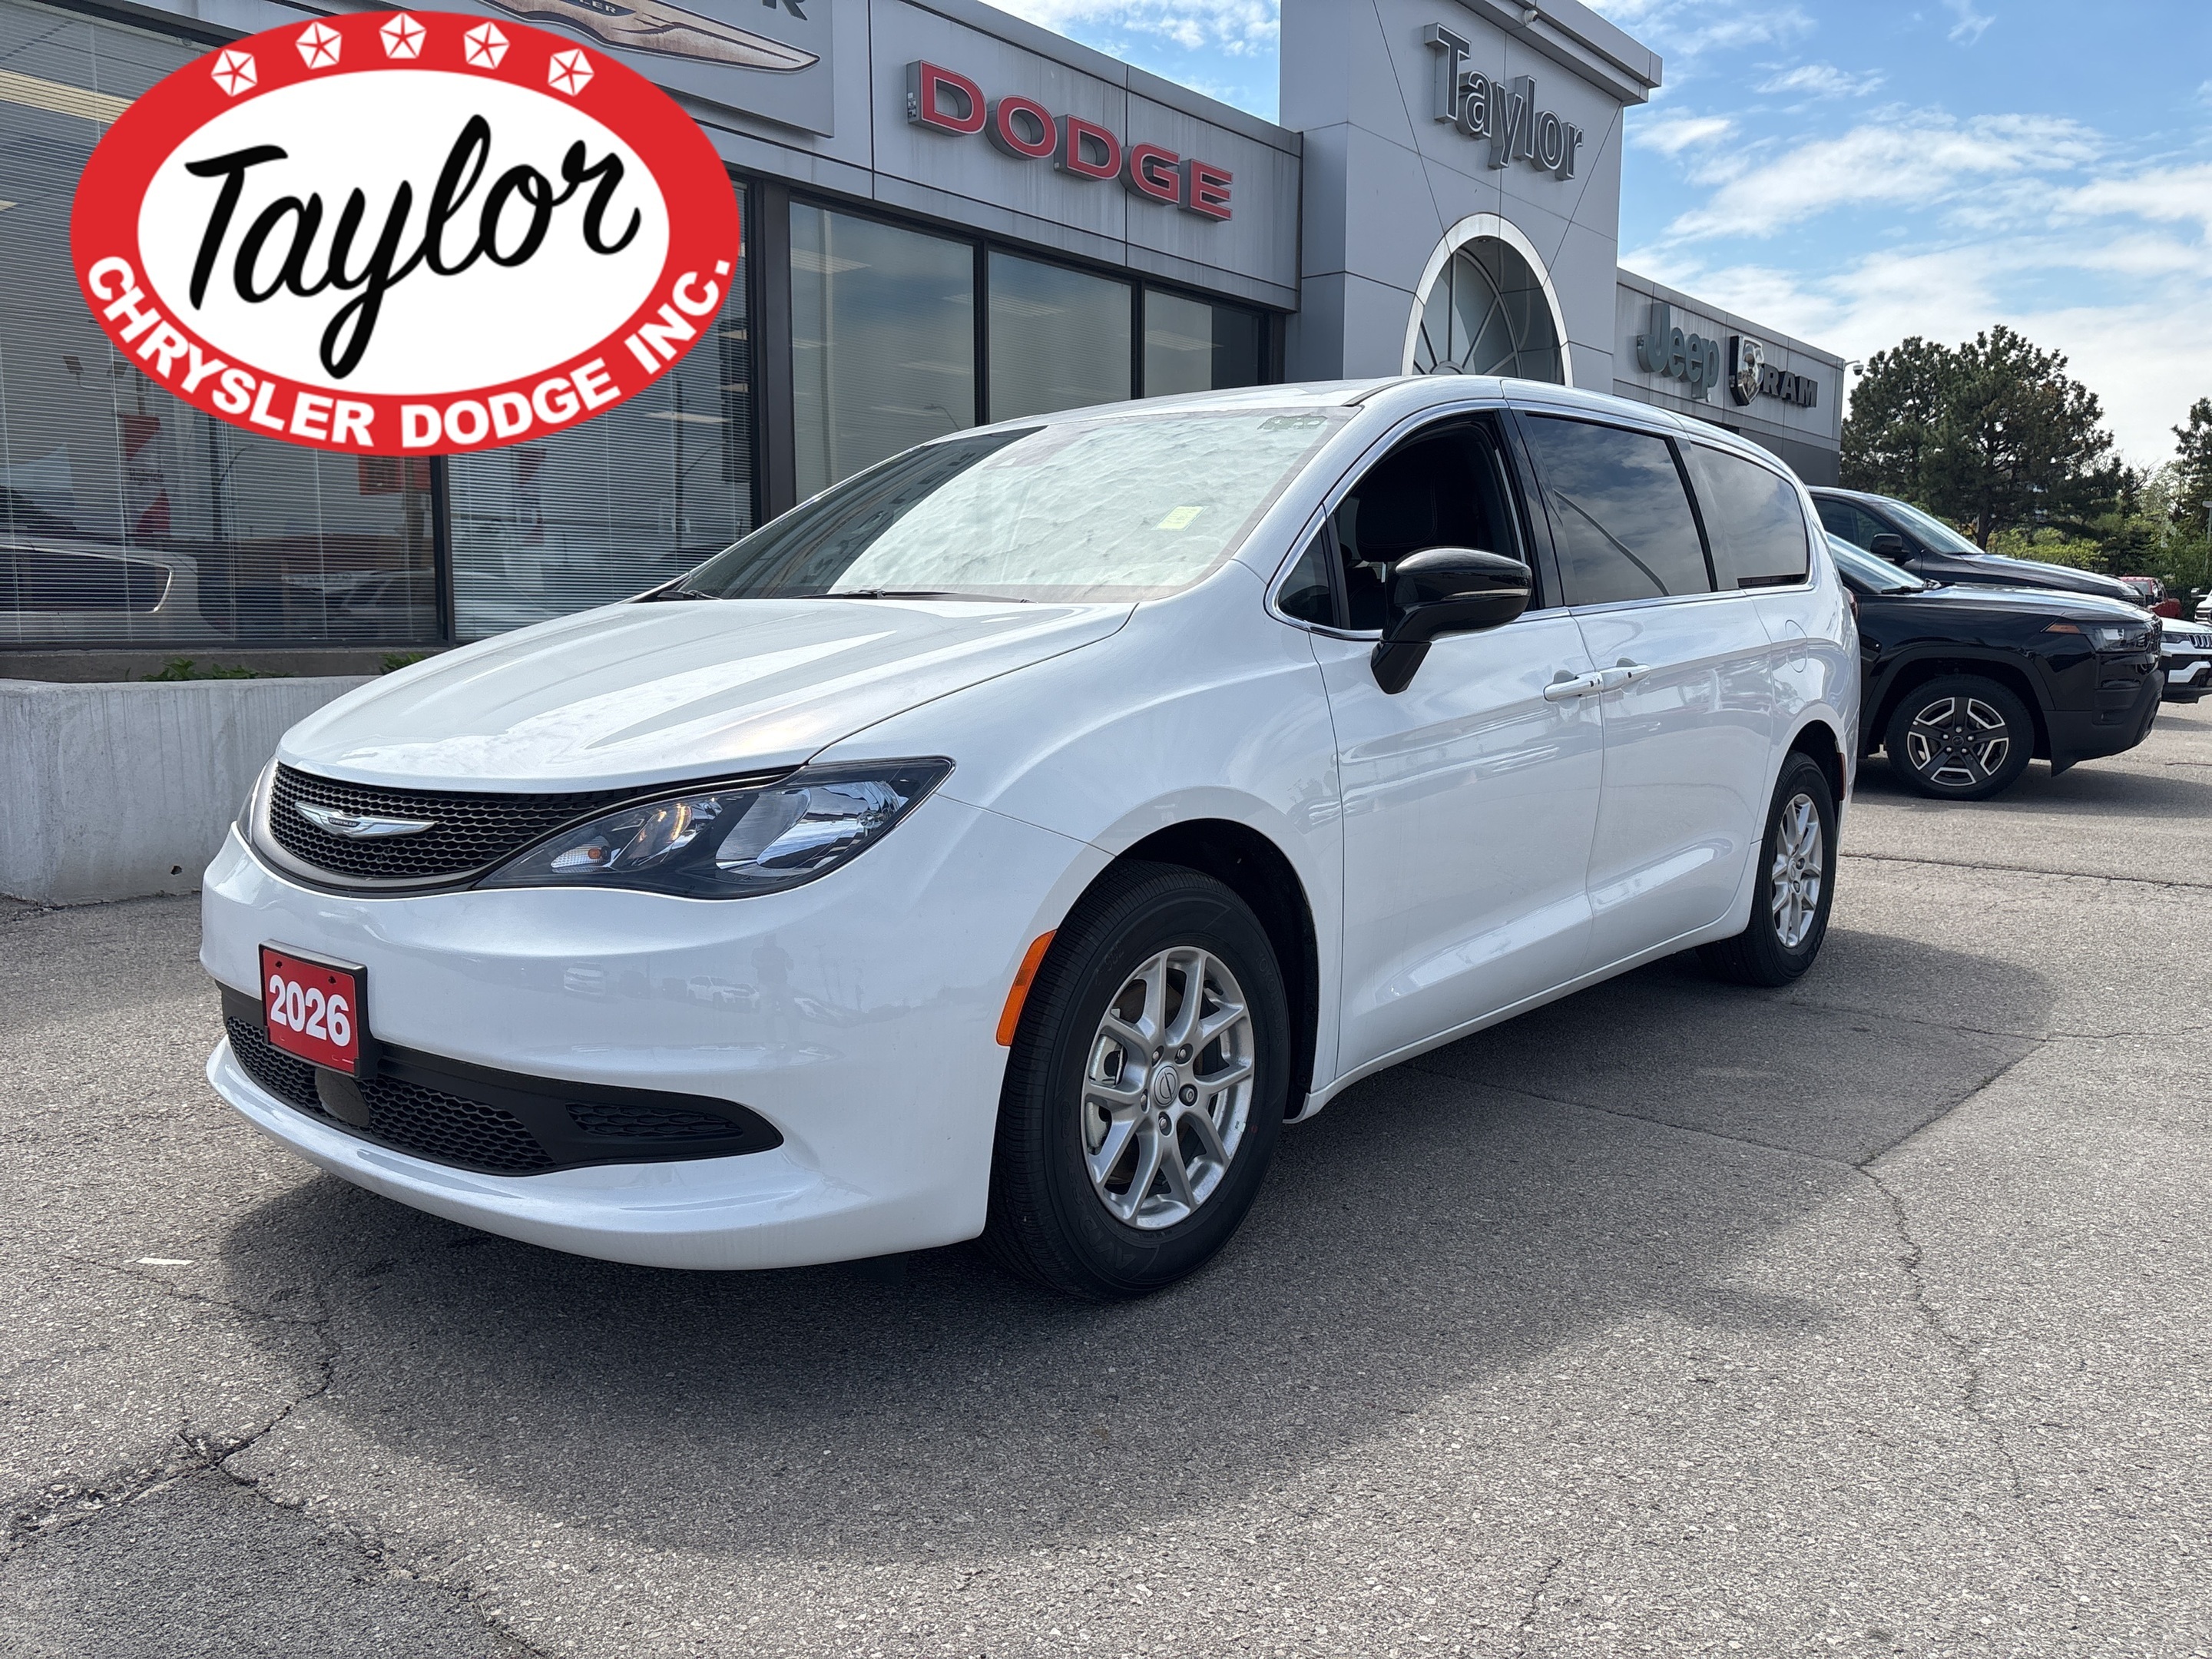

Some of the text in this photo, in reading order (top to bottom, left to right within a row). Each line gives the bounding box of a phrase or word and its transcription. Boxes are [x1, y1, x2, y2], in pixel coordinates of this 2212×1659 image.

[916, 60, 1233, 220] DODGE
[1433, 22, 1584, 180] Taylor
[1642, 303, 1720, 399] Jeep
[1763, 363, 1818, 408] RAM
[270, 974, 351, 1047] 2026
